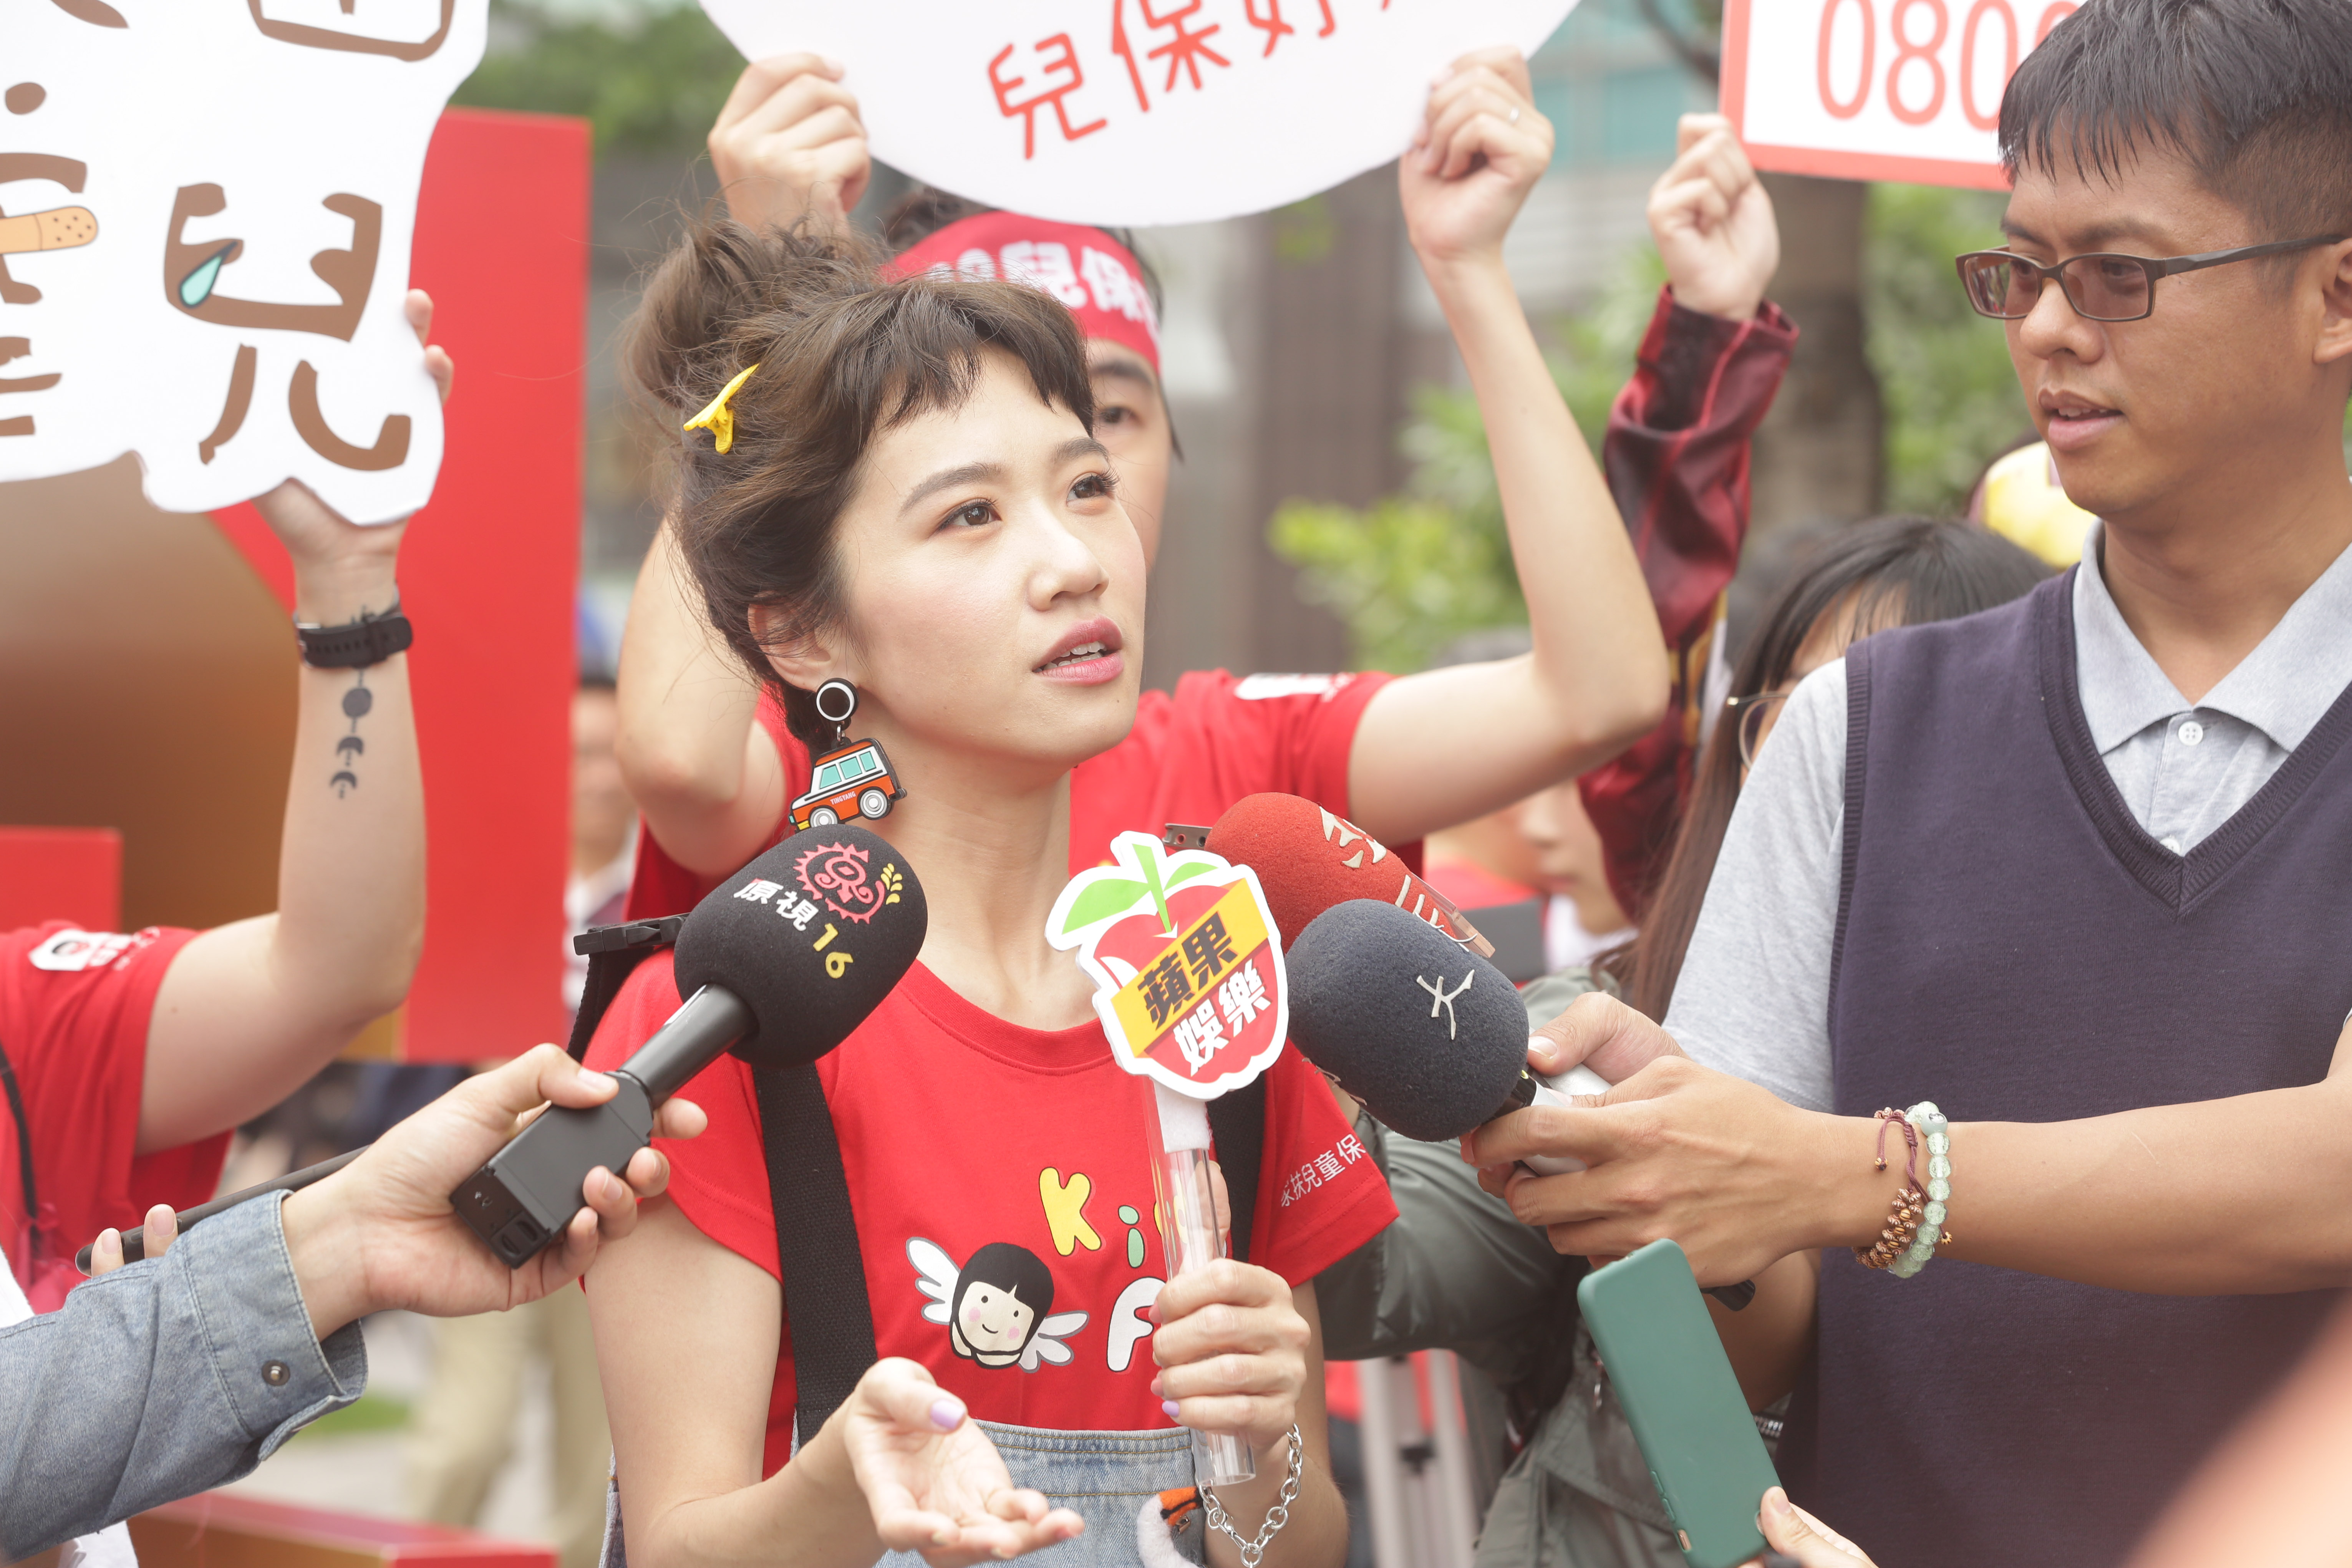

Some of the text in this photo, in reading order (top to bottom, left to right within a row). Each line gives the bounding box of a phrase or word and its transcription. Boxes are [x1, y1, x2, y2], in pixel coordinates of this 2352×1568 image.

[830, 791, 856, 805] TINGYANG
[1137, 910, 1238, 1031] 蘋果
[1173, 958, 1271, 1077] 娛樂
